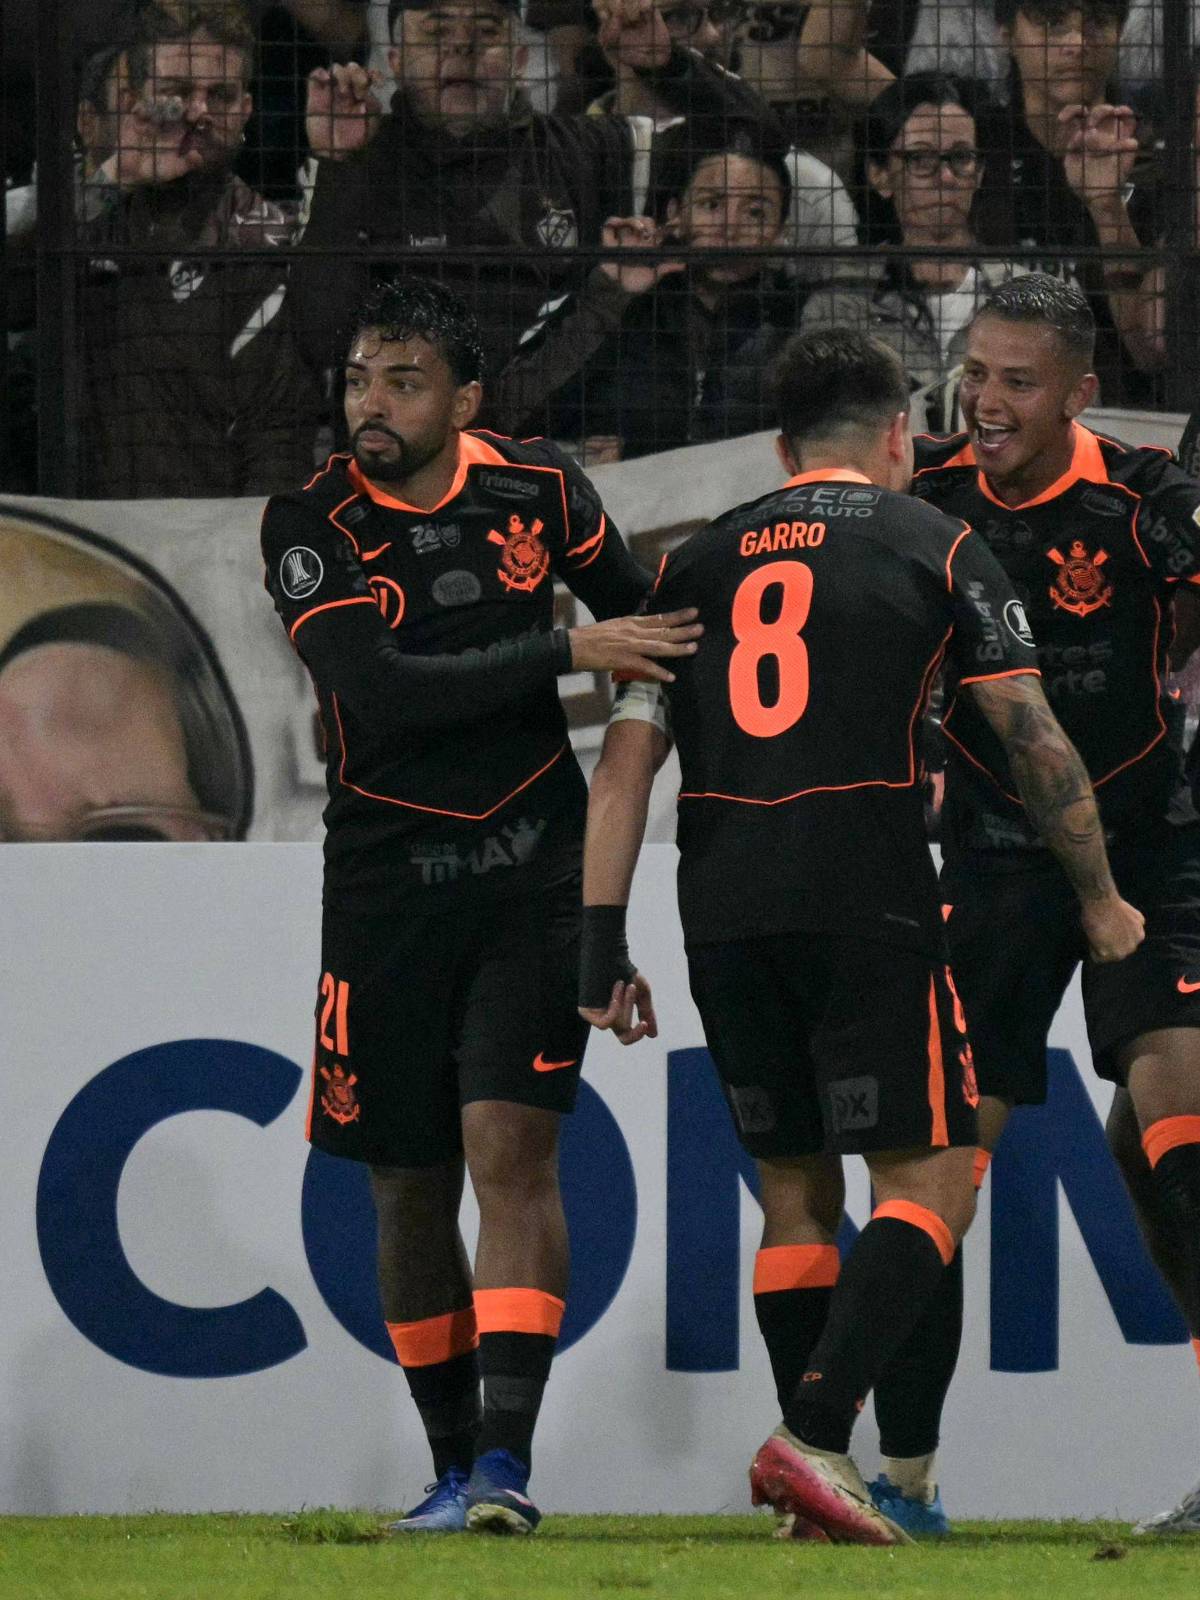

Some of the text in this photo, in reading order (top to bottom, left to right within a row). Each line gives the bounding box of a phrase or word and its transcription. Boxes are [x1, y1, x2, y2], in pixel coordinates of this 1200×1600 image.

[739, 521, 827, 557] GARRO
[808, 506, 875, 518] AUTO
[728, 560, 814, 738] 8
[319, 971, 351, 1057] 21
